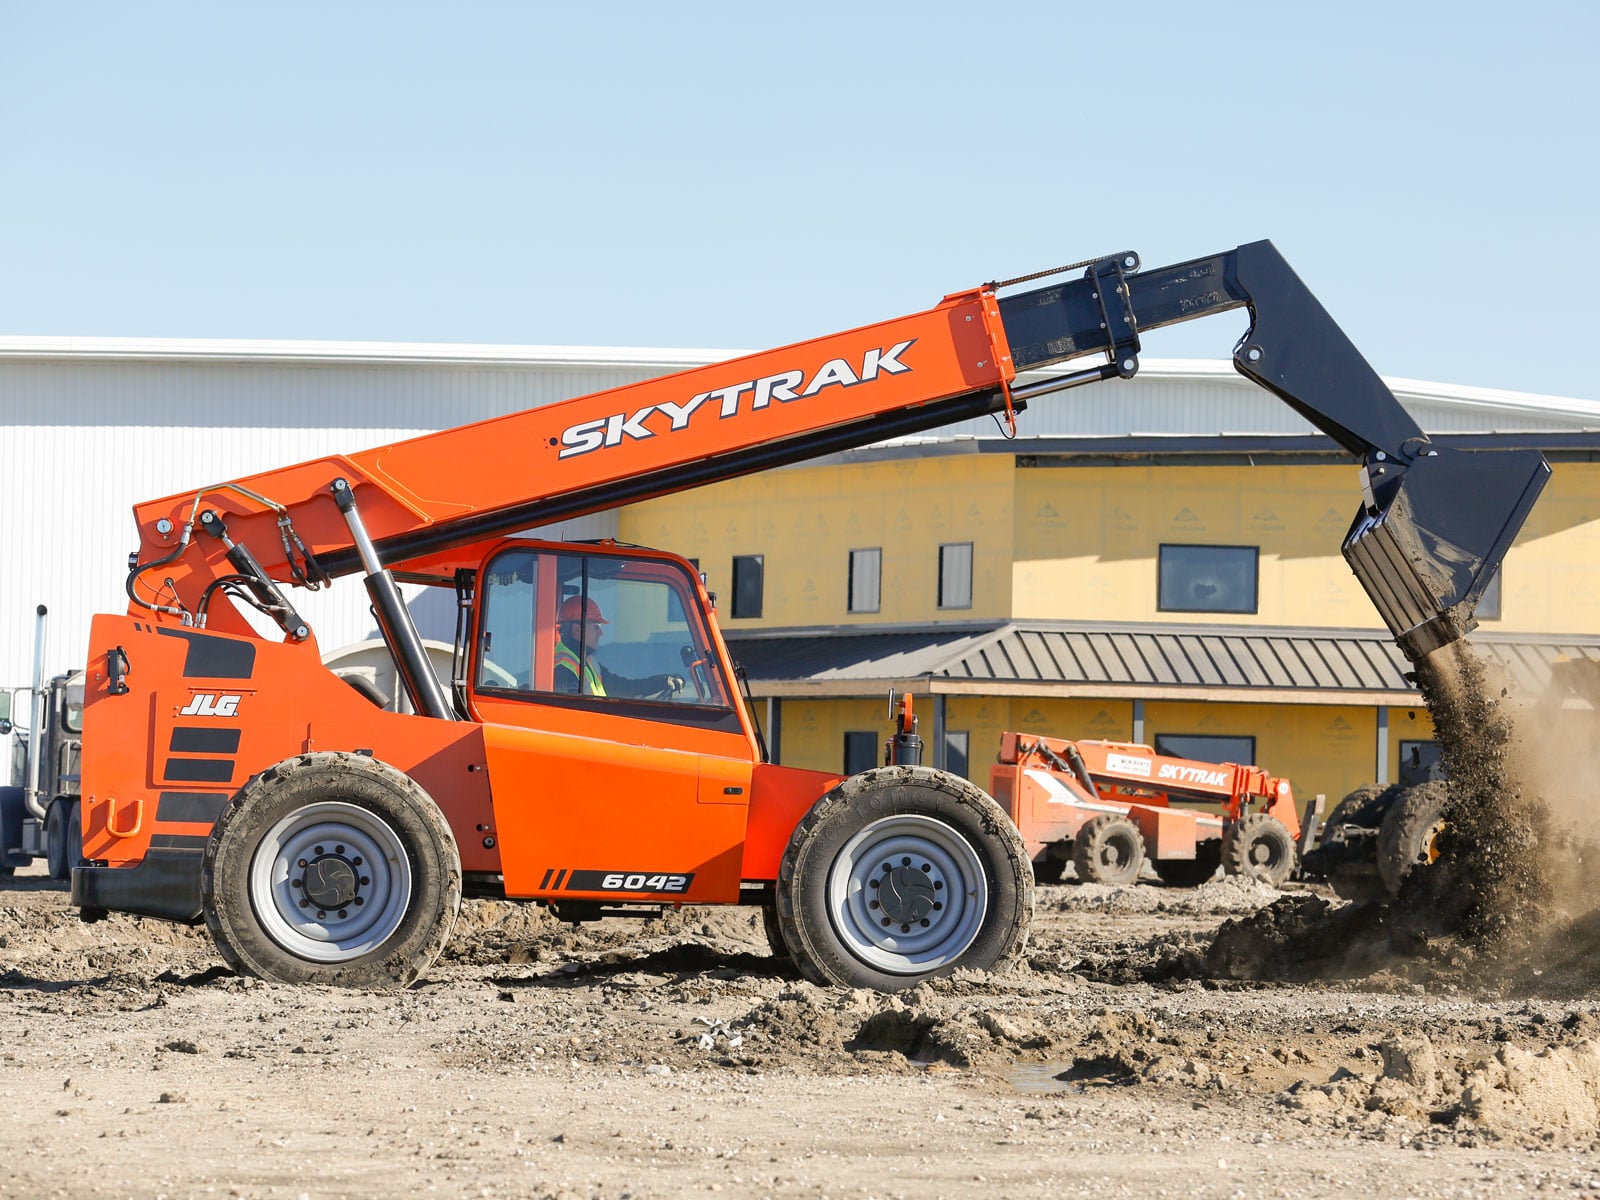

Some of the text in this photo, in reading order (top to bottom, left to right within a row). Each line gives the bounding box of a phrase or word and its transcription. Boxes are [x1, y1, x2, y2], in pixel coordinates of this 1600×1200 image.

[558, 338, 919, 460] SKYTRAK
[180, 694, 242, 717] JLG
[1158, 763, 1228, 786] SKYTRAK
[601, 873, 687, 892] 6042
